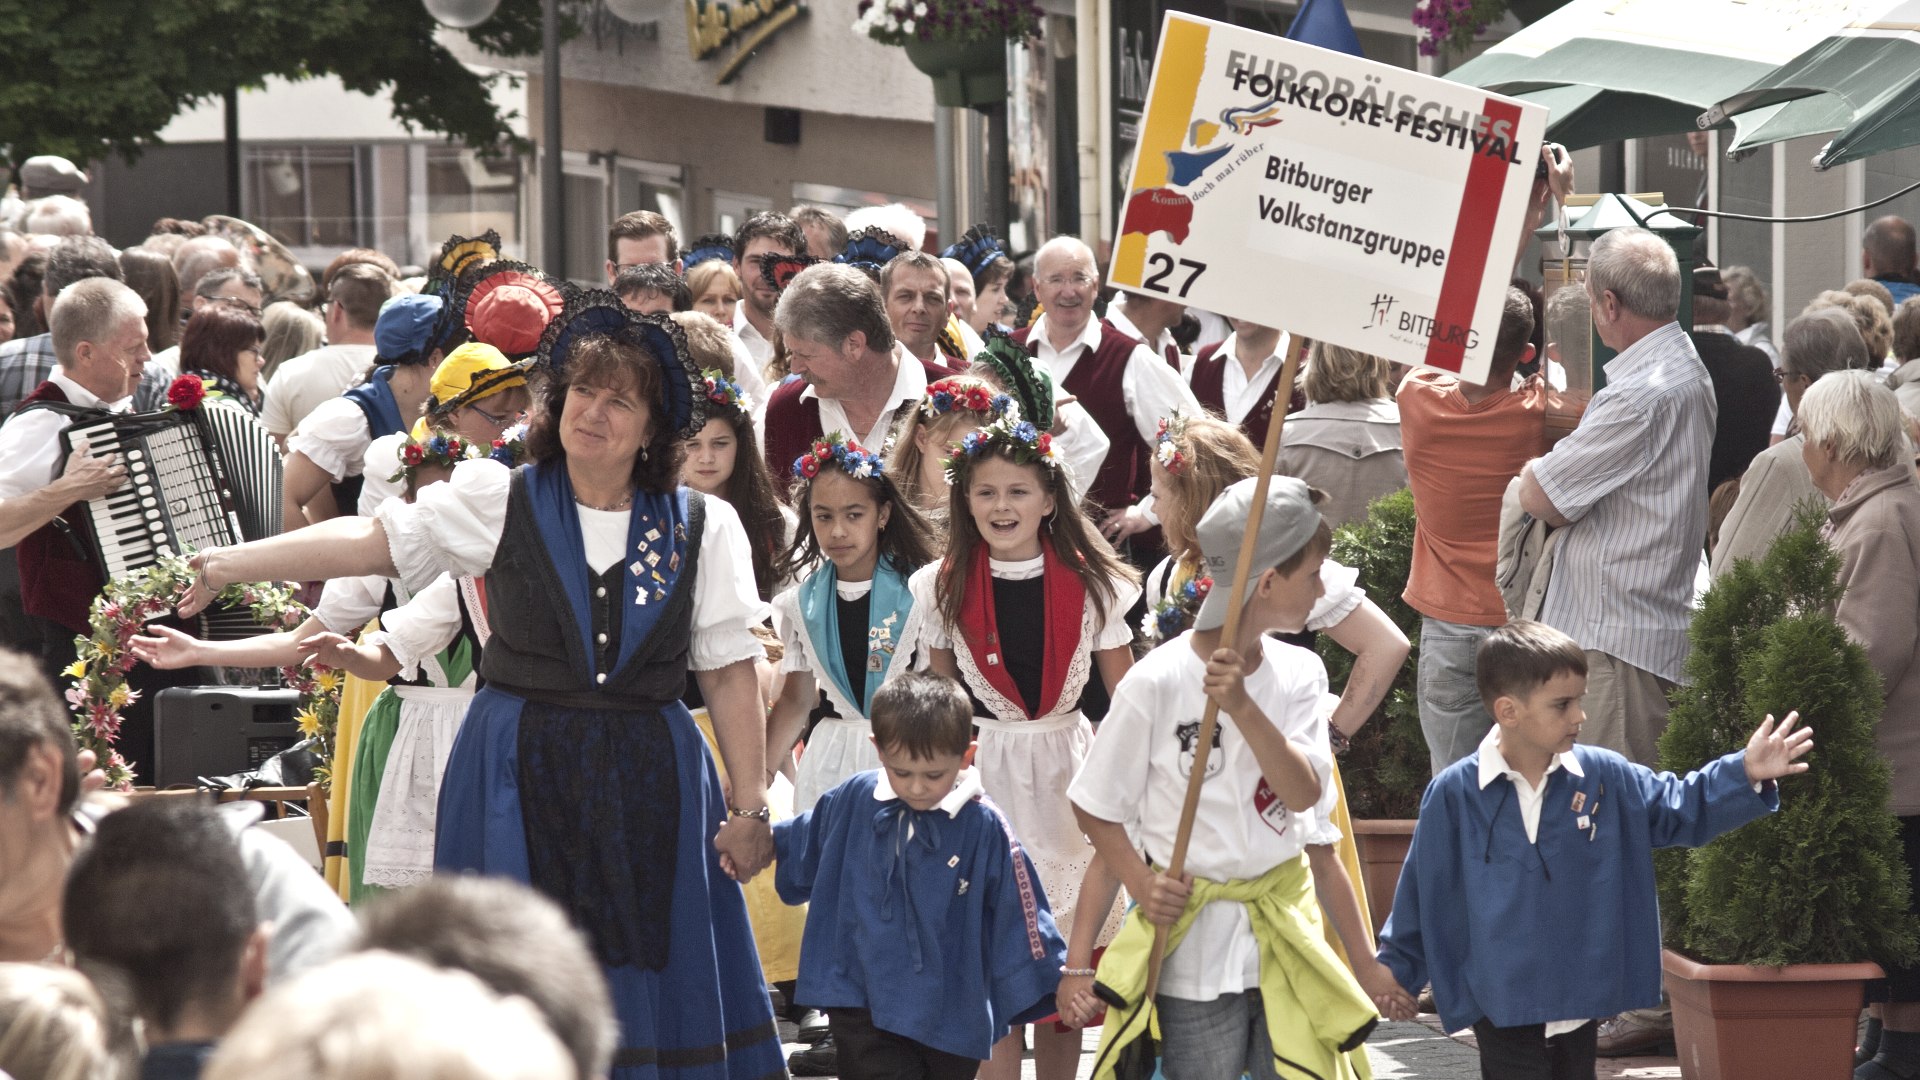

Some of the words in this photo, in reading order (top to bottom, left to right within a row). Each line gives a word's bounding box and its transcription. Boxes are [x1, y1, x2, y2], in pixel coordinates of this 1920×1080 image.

[1225, 49, 1512, 150] EUROPÄISCHES
[1233, 68, 1522, 165] FOLKLORE-FESTIVAL
[1151, 192, 1189, 206] Komm
[1192, 180, 1216, 202] doch
[1215, 163, 1235, 183] mal
[1235, 142, 1264, 167] rüber
[1265, 155, 1373, 204] Bitburger
[1259, 194, 1445, 267] Volkstanzgruppe
[1143, 252, 1207, 298] 27
[1398, 310, 1479, 349] BITBURG
